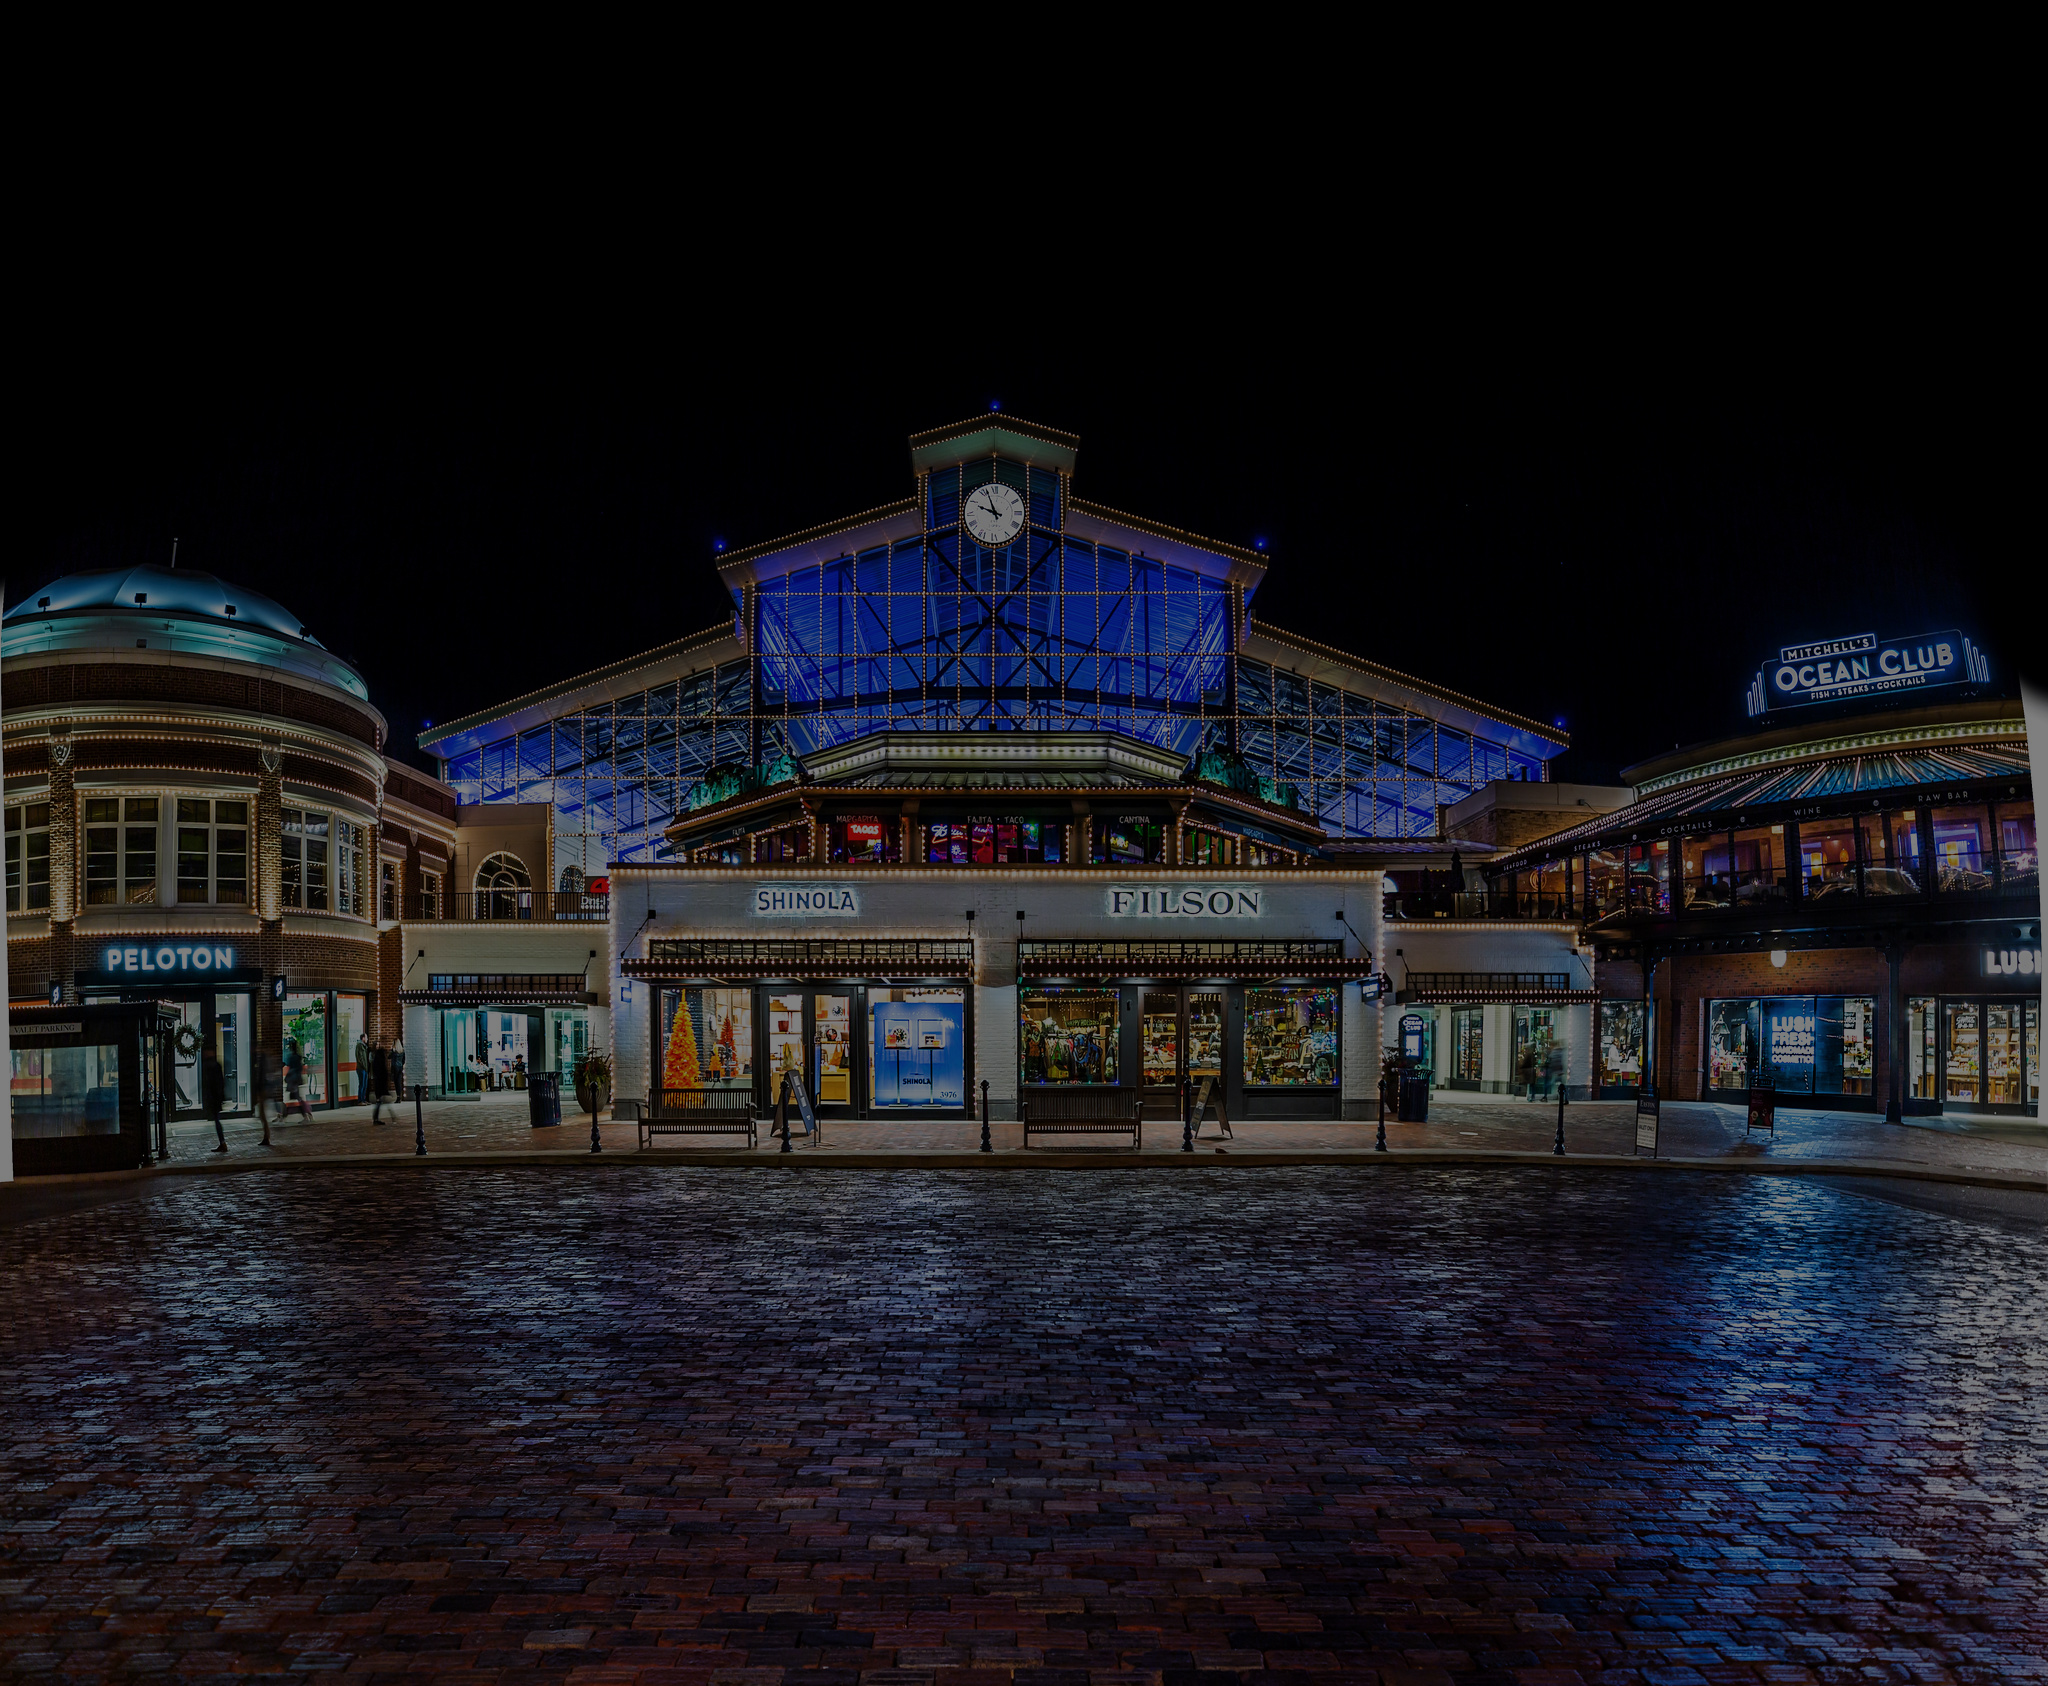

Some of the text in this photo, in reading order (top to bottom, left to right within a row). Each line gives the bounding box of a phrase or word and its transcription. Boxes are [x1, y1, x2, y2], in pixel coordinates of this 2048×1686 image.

[1787, 638, 1870, 660] MITCHELL'S
[1775, 643, 1954, 691] OCEAN CLUB
[1811, 675, 1926, 700] FISH STEAKS COCKTAILS
[1918, 791, 1969, 803] RAW BAR
[1794, 806, 1821, 816] WINE
[836, 815, 879, 823] MARGARITA
[967, 815, 1025, 824] FAJITA TACO
[1119, 815, 1150, 824] CANTINA
[1660, 820, 1713, 835] COCKTAILS
[1573, 840, 1601, 852] STEAKS
[758, 891, 855, 911] SHINOLA
[1111, 891, 1260, 915] FILSON
[107, 947, 232, 972] PELOTON
[14, 1024, 75, 1034] VALET PARKING
[1771, 1016, 1815, 1032] LUSH
[1771, 1031, 1814, 1046] FRESH
